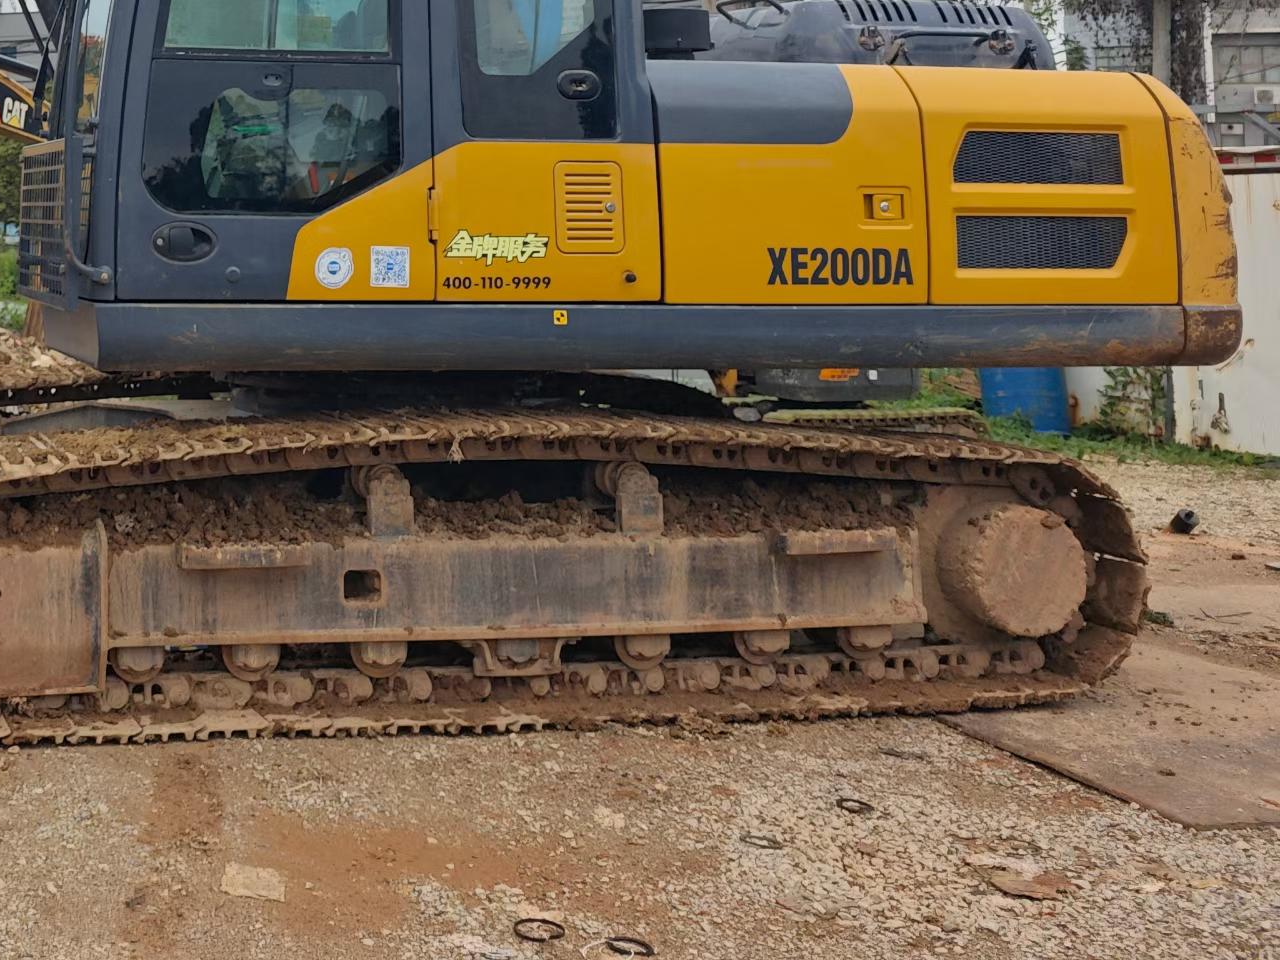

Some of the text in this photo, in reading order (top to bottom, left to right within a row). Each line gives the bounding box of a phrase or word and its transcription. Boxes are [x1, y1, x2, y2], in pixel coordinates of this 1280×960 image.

[2, 97, 29, 129] CAT
[442, 229, 550, 266] 金牌服务
[442, 276, 551, 290] 400-110-9999
[767, 247, 914, 286] XE200DA
